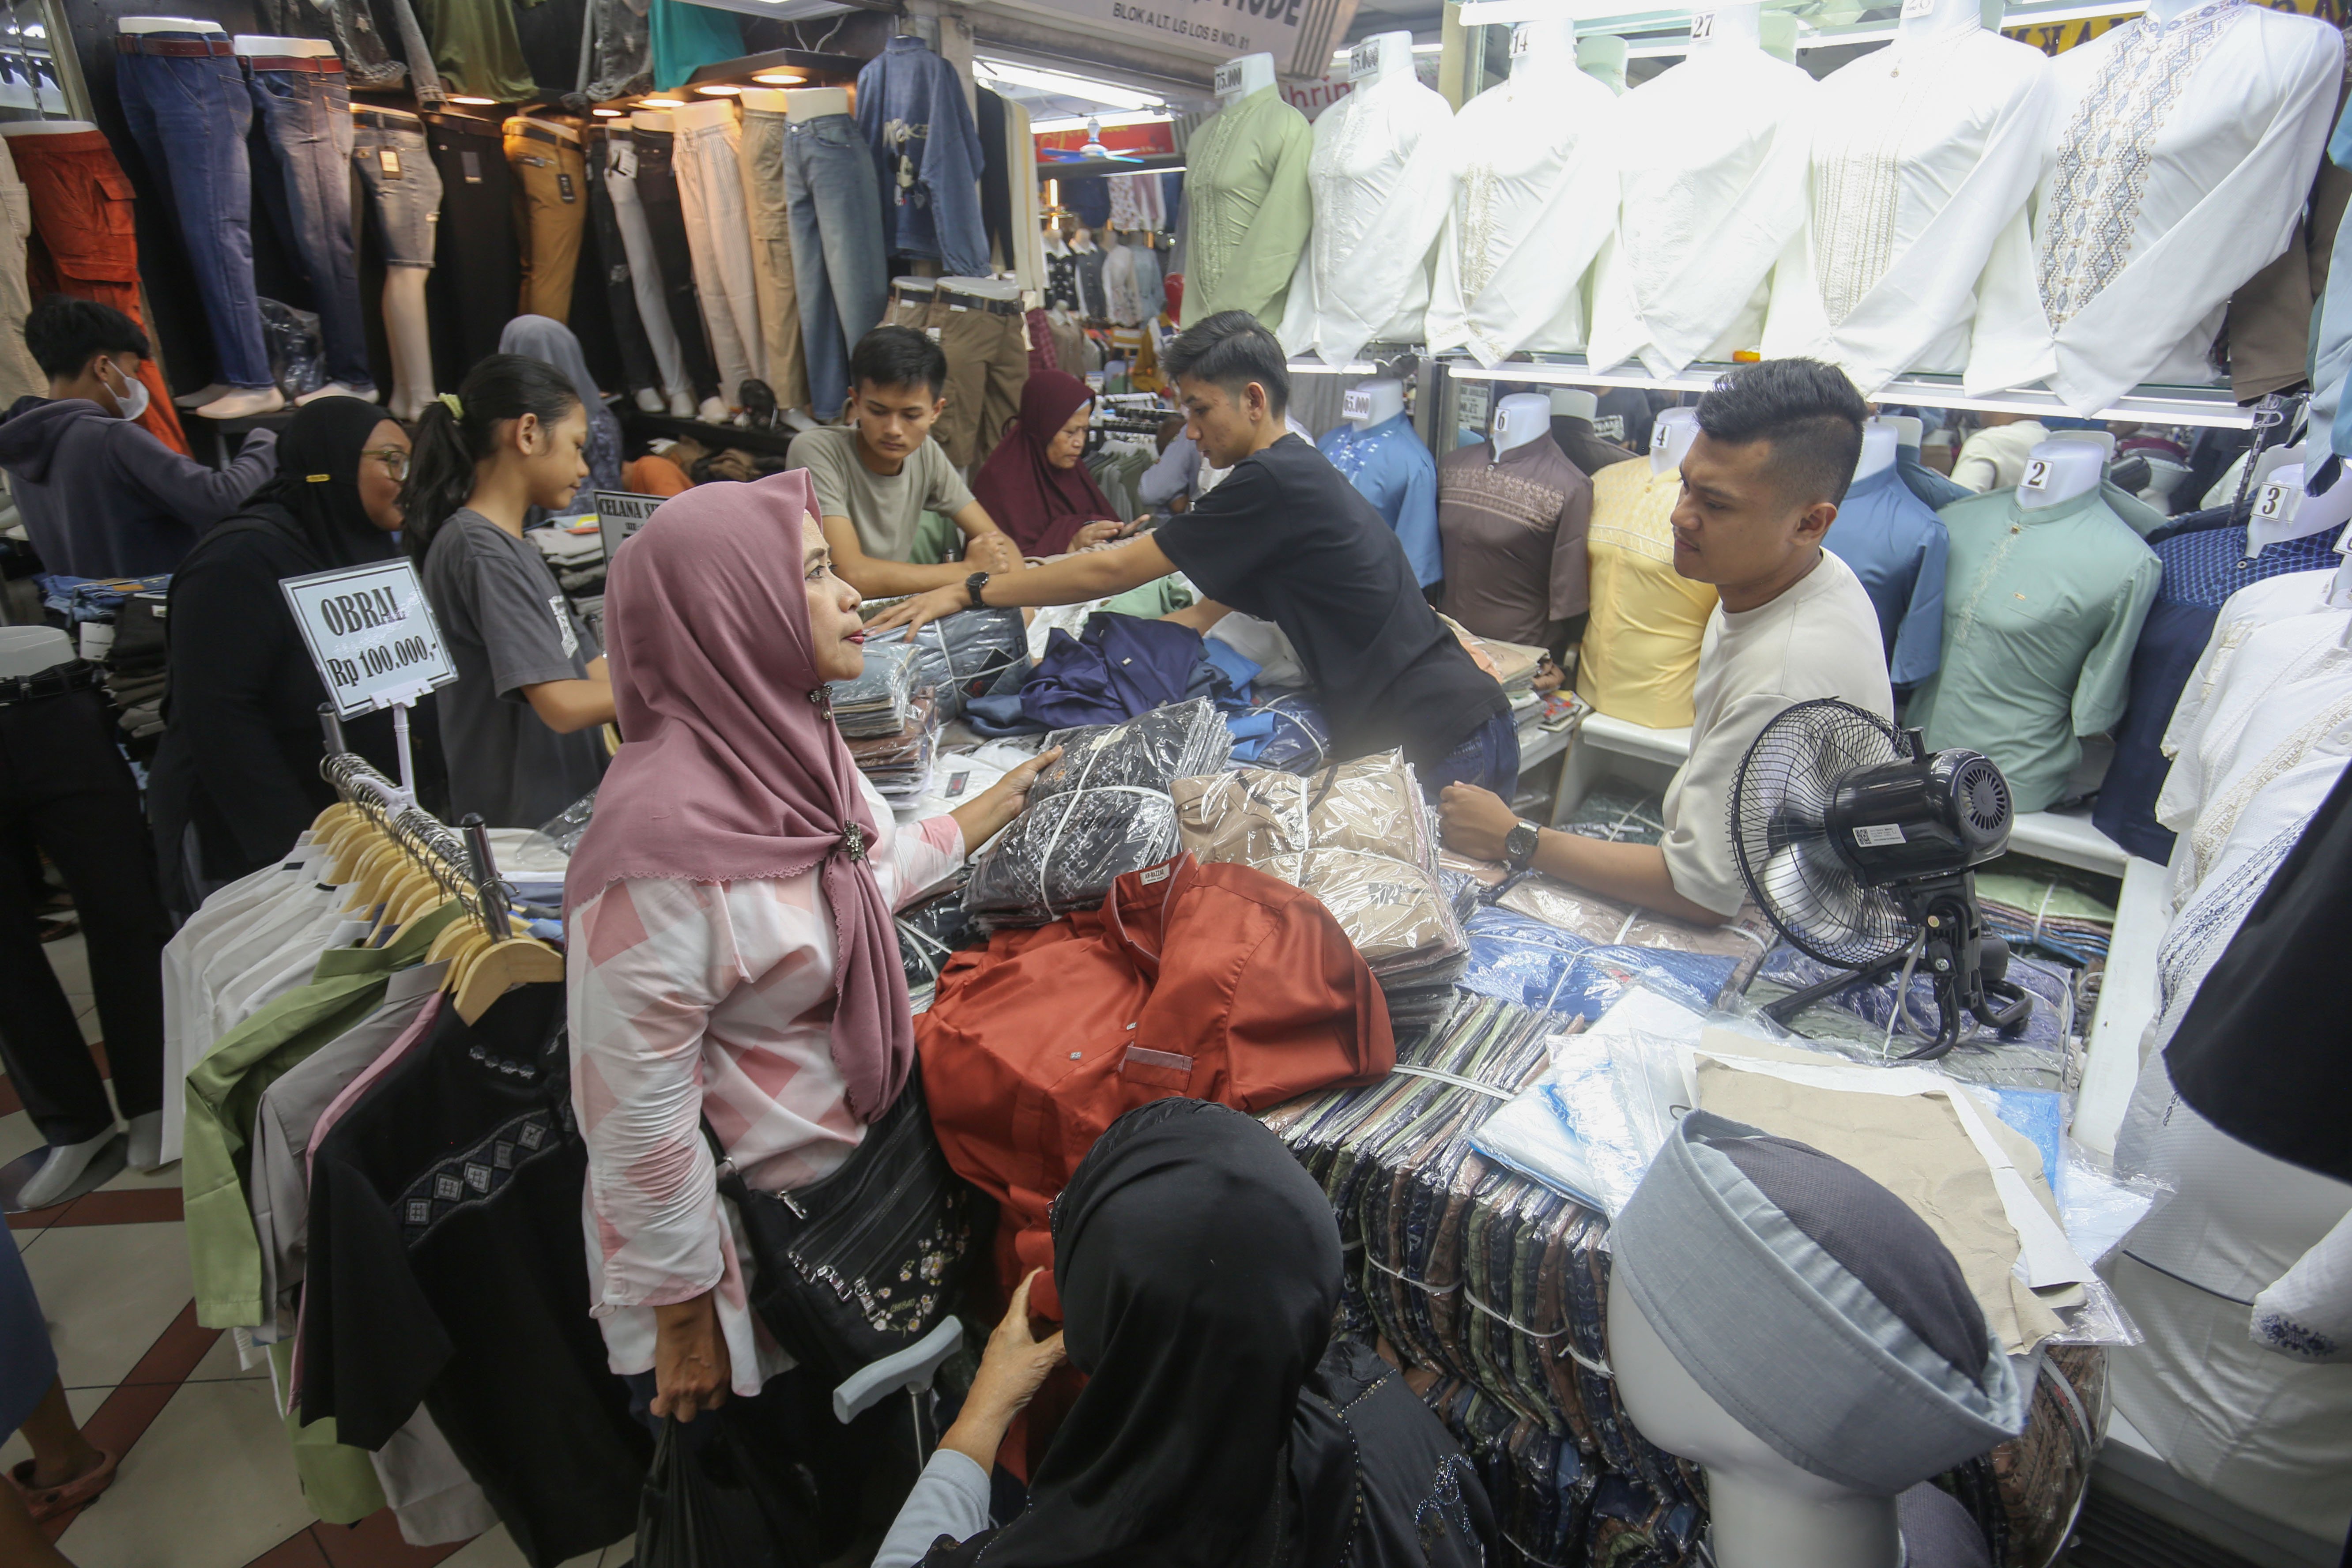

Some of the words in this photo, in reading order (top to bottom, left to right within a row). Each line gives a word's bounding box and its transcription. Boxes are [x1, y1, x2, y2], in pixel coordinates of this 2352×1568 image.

[1112, 2, 1146, 23] BLOK
[1146, 11, 1154, 26] A
[1172, 18, 1187, 34] LG
[1189, 23, 1210, 40] LOS
[1692, 14, 1715, 39] 27
[1513, 29, 1528, 54] 14
[1498, 411, 1506, 430] 6
[1657, 426, 1667, 446] 4
[2028, 461, 2046, 486] 2
[598, 498, 642, 518] CELANA
[2262, 487, 2280, 515] 3
[320, 586, 407, 637] OBRAL
[326, 658, 359, 687] Rp
